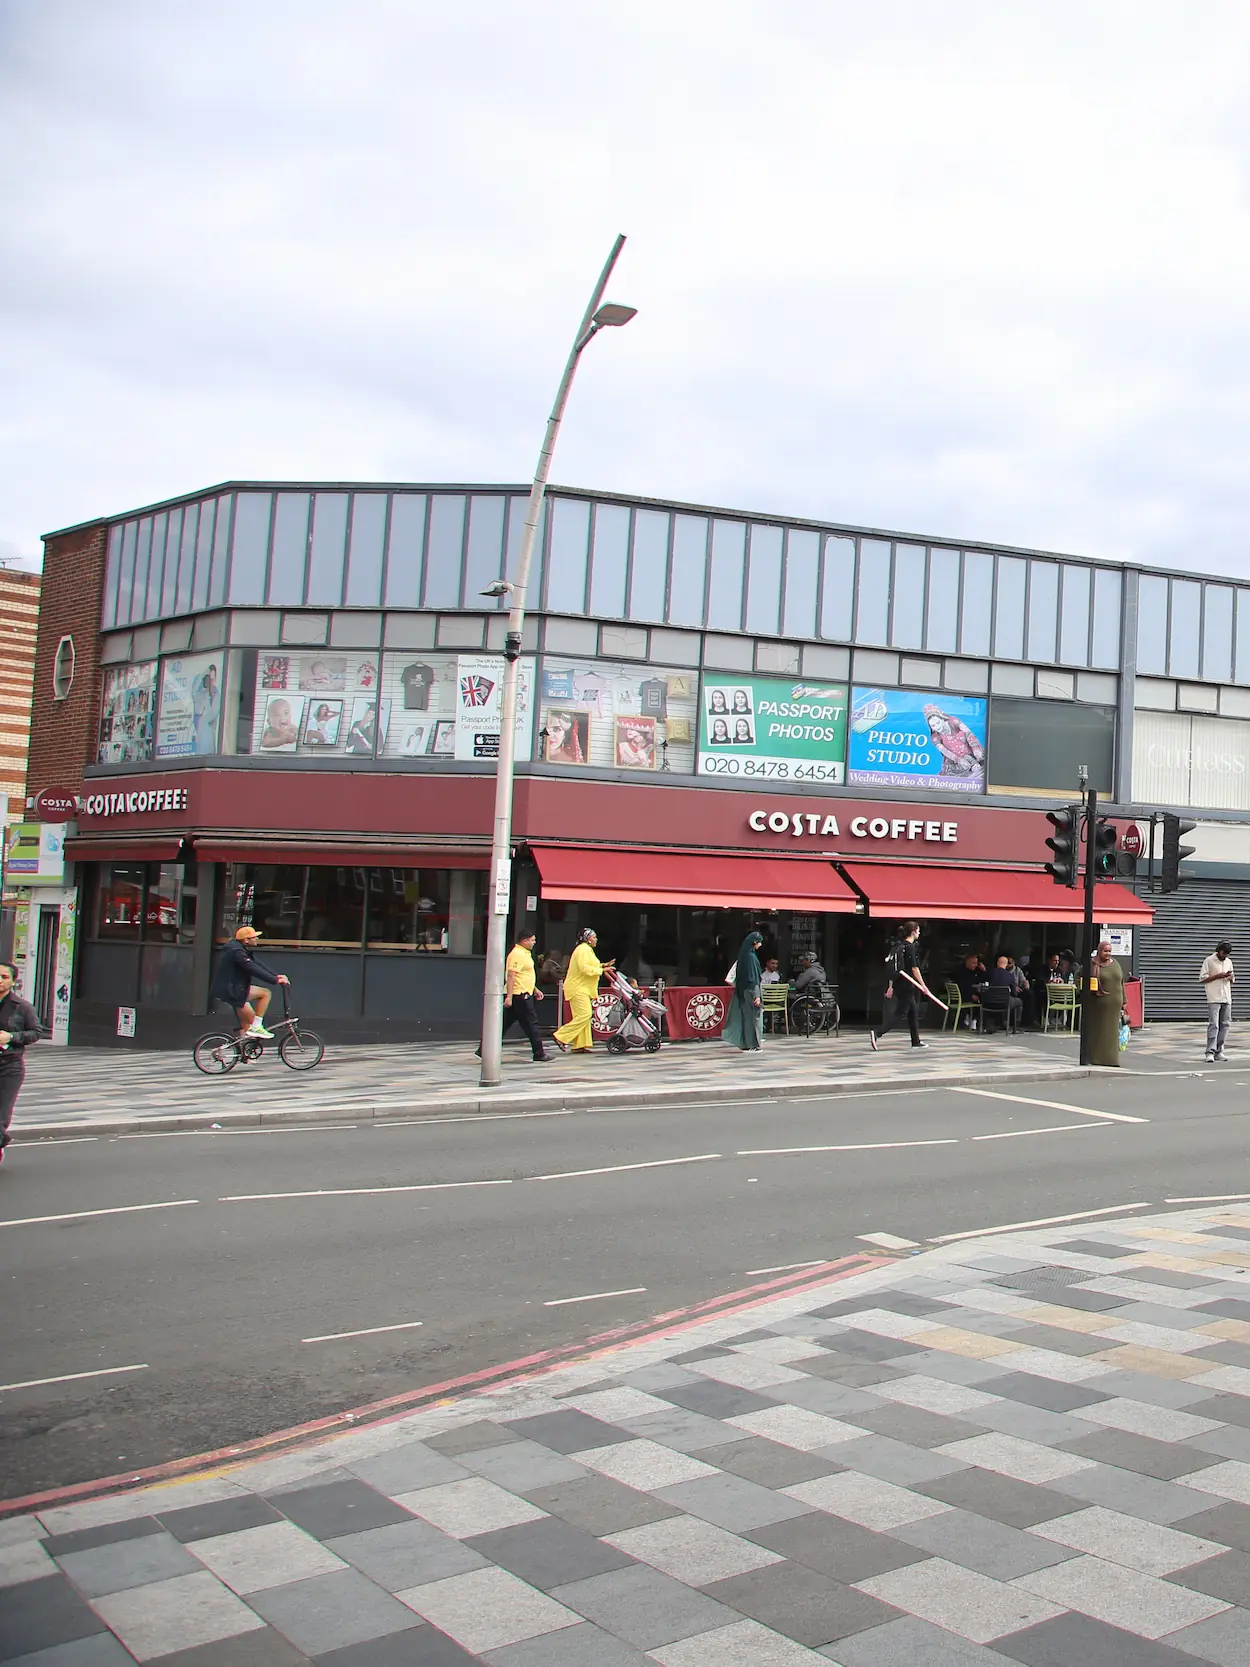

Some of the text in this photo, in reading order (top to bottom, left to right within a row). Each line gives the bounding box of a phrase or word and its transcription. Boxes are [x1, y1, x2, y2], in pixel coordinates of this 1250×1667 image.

[757, 700, 843, 721] PASSPORT
[461, 716, 491, 724] Passport
[768, 723, 835, 743] PHOTOS
[867, 730, 928, 748] PHOTO
[867, 749, 930, 766] STUDIO
[1148, 742, 1245, 774] Cutlass
[705, 757, 837, 781] 020 8478 6454
[850, 772, 982, 791] Wedding Video & Photography
[41, 798, 73, 808] COSTA
[87, 789, 188, 817] COSTA COFFEE
[749, 810, 959, 843] COSTA COFFEE
[1126, 836, 1139, 845] COSTA
[691, 993, 719, 1006] COSTA
[688, 1014, 721, 1029] COFFEE
